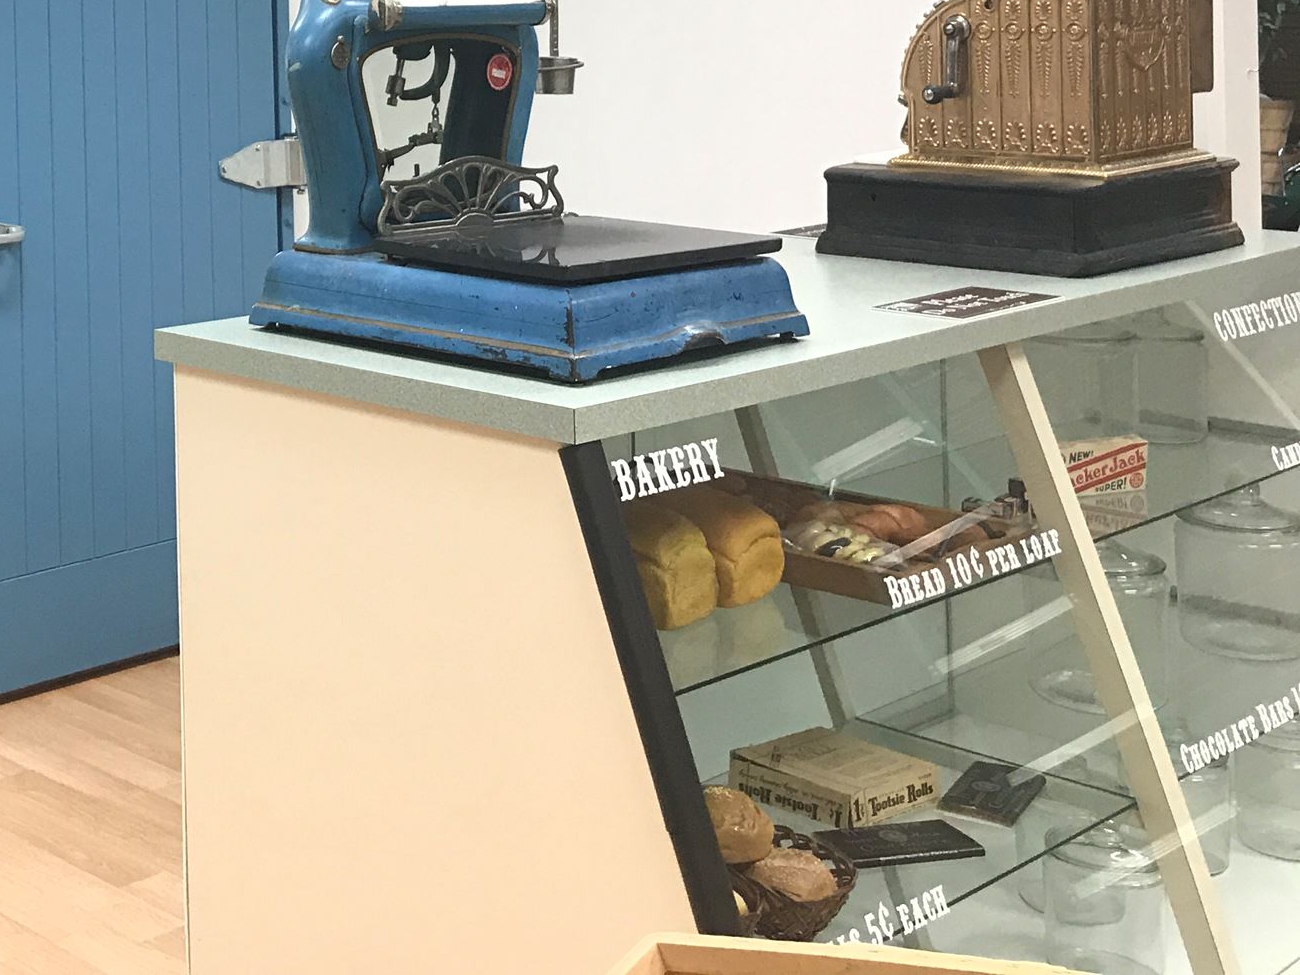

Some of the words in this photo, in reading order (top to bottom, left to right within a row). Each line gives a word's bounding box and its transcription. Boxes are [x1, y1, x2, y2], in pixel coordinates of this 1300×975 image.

[611, 437, 725, 502] BAKERY
[1069, 450, 1094, 464] NEW!
[883, 567, 946, 610] BREAD
[946, 546, 984, 589] 10¢
[985, 543, 1022, 576] PER
[1019, 528, 1062, 565] LOAF
[1180, 715, 1260, 774] CHOCOLATE
[1254, 703, 1294, 734] BARS
[1290, 681, 1300, 715] 1
[868, 794, 906, 817] Tootsie
[906, 782, 934, 803] Rolls
[864, 901, 894, 945] 5¢
[896, 884, 951, 936] EACH
